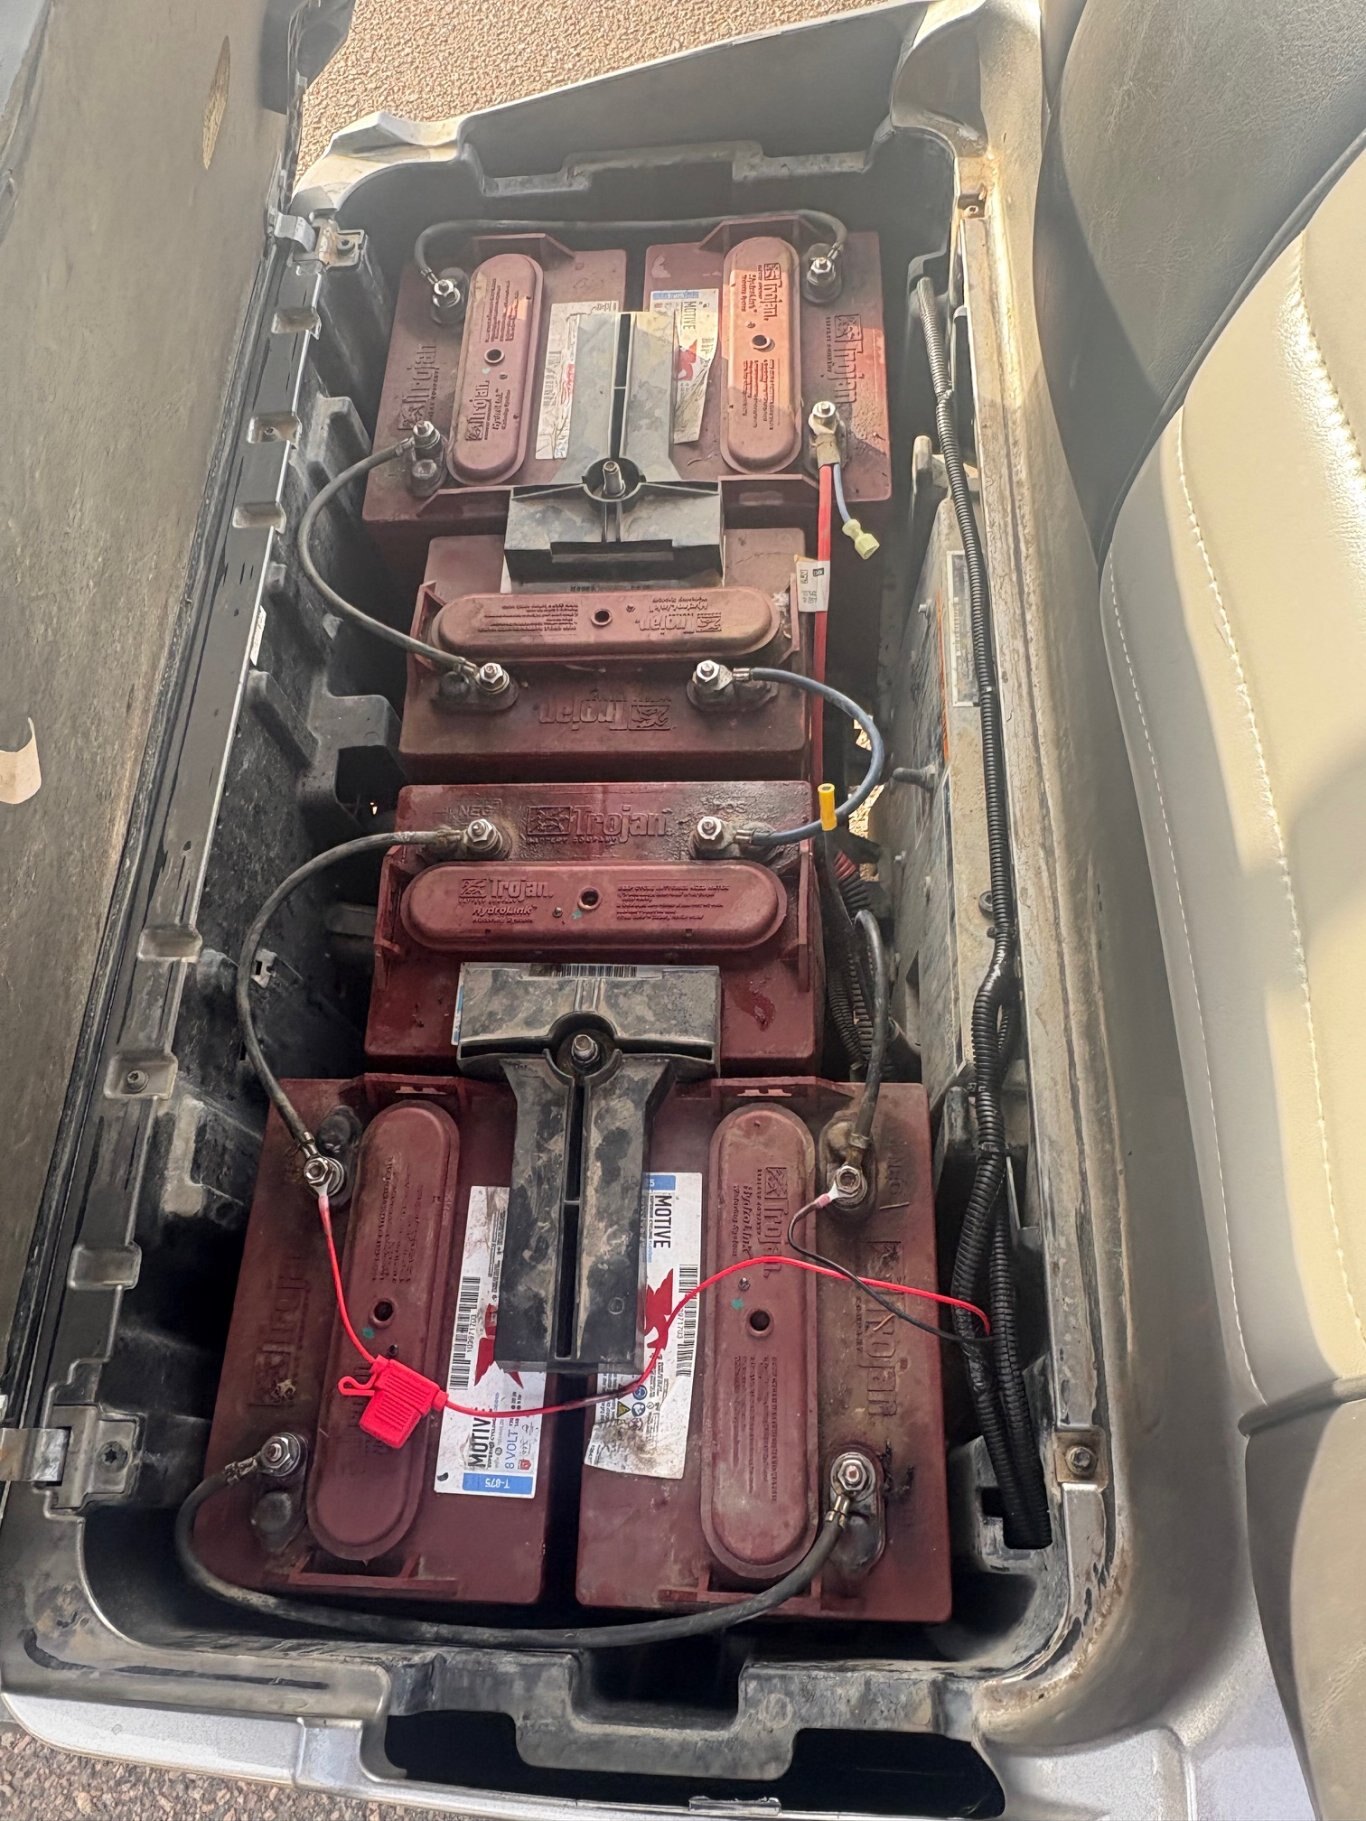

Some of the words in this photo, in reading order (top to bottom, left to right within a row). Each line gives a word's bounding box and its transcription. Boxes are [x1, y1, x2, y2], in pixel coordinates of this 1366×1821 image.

[683, 301, 697, 330] MOTIVE
[760, 279, 783, 318] Trojan
[401, 344, 440, 402] Trojan
[828, 340, 866, 405] Trojan
[467, 384, 491, 423] Trojan
[639, 613, 695, 635] Trojan
[539, 691, 628, 731] Trojan
[570, 804, 667, 844] Trojan
[488, 877, 549, 903] Trojan
[653, 1195, 672, 1249] MOTIVE
[757, 1199, 789, 1272] Trojan
[468, 1407, 493, 1468] MOTIV
[505, 1429, 519, 1460] VOLT
[485, 1478, 510, 1489] T-875
